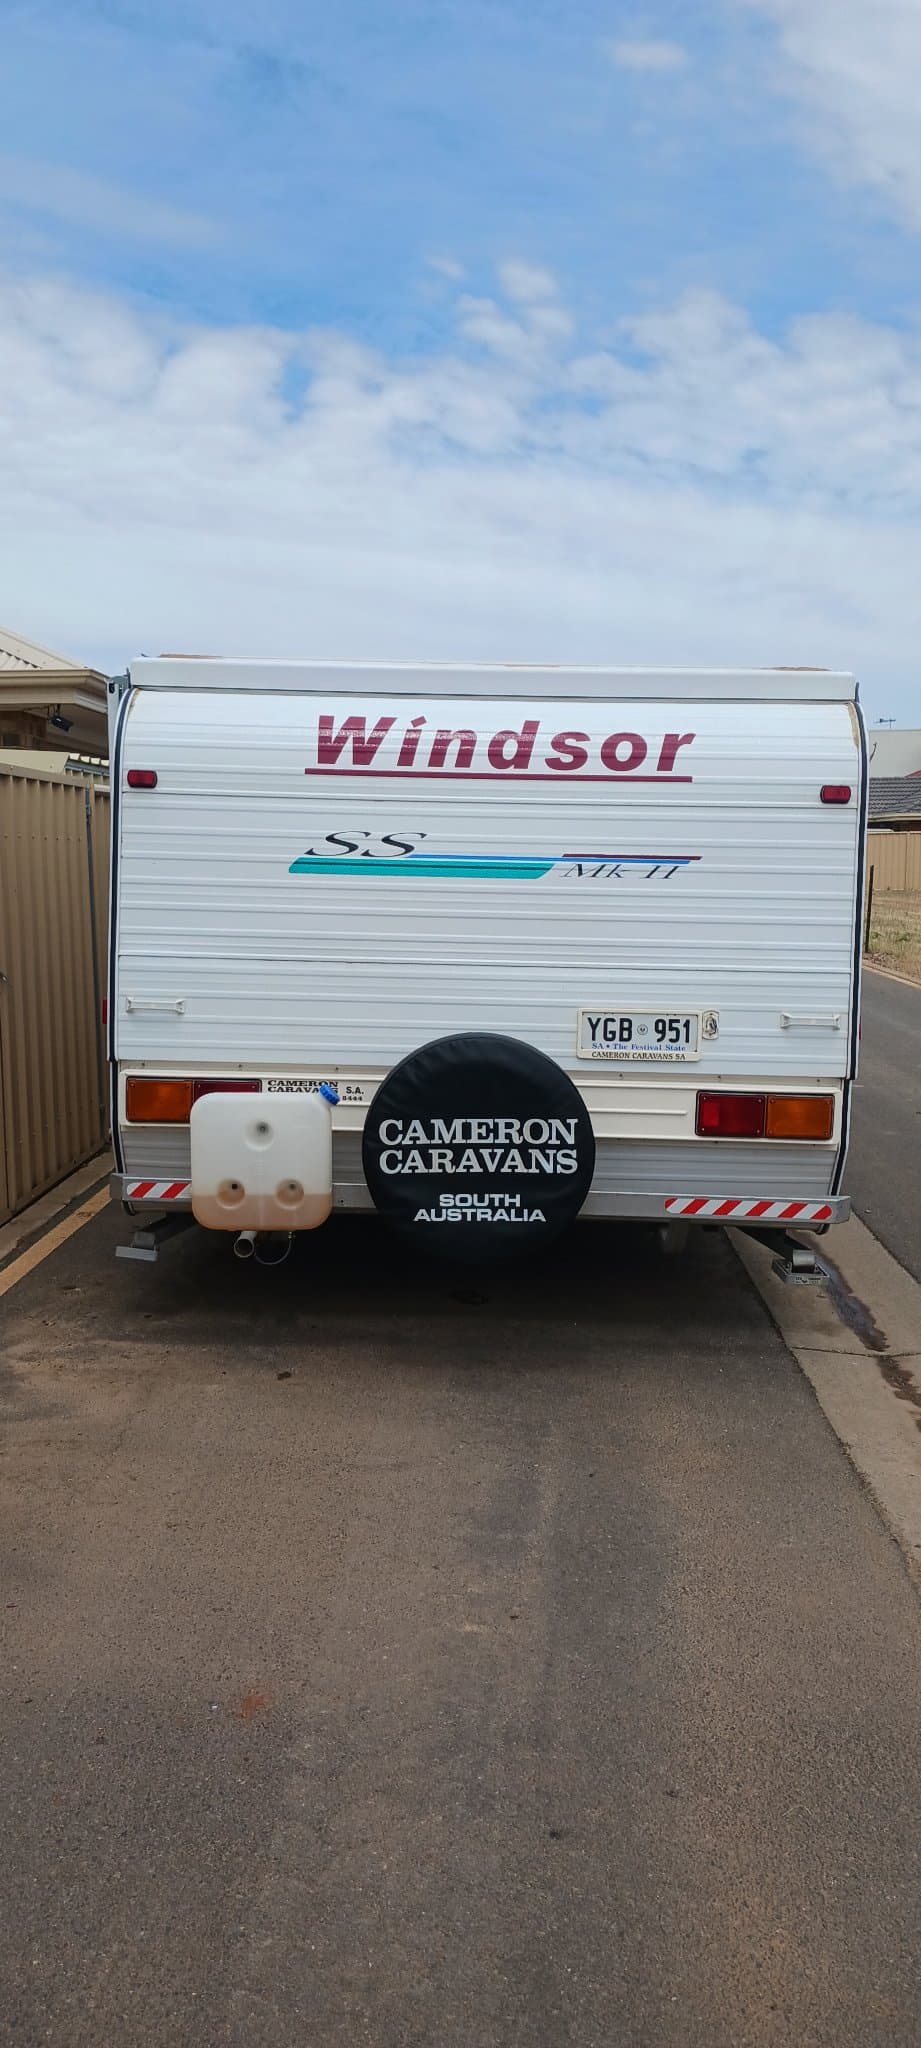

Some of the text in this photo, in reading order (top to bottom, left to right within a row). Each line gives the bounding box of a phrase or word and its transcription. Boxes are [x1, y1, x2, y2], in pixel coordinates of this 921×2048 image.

[317, 715, 696, 772] Windsor
[304, 831, 427, 857] SS
[560, 863, 682, 879] Mk II
[587, 1017, 691, 1043] YGB 951
[592, 1051, 630, 1059] CAMERON
[633, 1052, 673, 1060] CARAVANS
[631, 1043, 662, 1051] Festival
[378, 1118, 579, 1146] CAMERON
[379, 1149, 578, 1175] CARAVANS
[439, 1193, 521, 1208] SOUTH
[413, 1208, 547, 1223] AUSTRALIA
